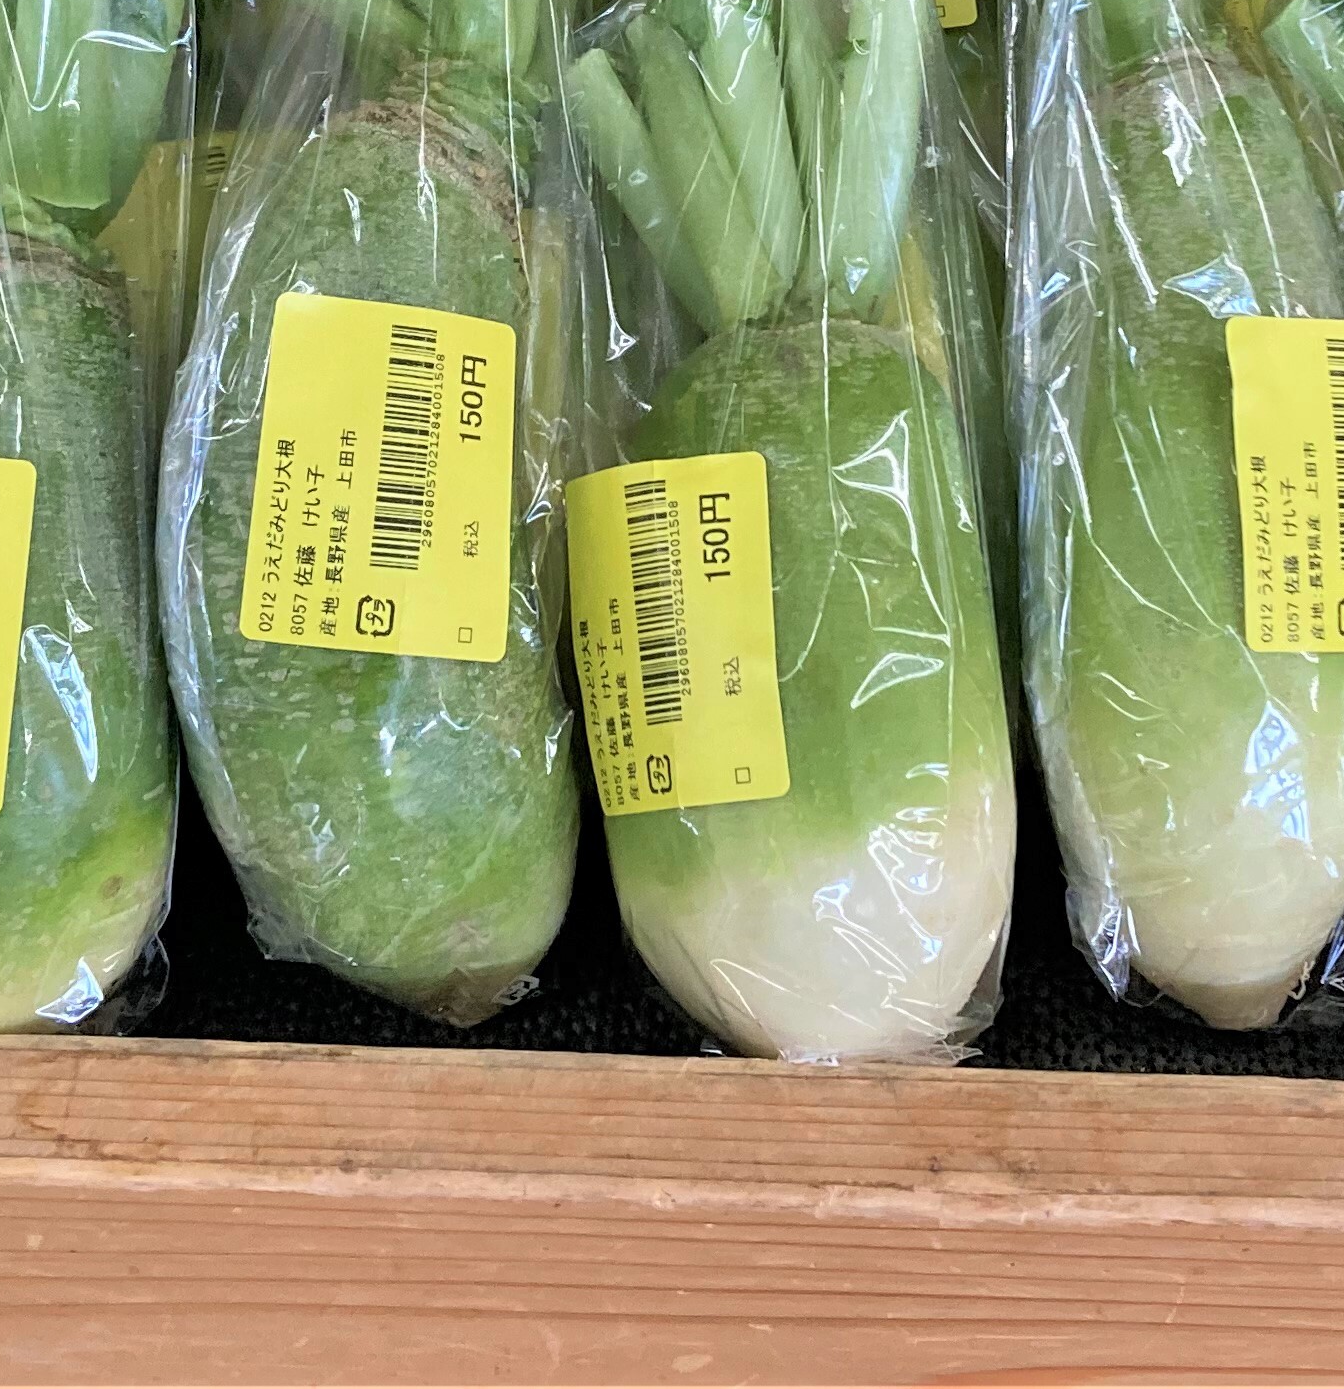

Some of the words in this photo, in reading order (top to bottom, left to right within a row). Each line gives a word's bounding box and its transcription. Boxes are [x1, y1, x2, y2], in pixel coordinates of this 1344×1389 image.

[458, 354, 487, 442] 150円
[335, 428, 357, 489] 上田市
[419, 353, 445, 548] 29608057021284001508
[1302, 441, 1318, 497] 上田市
[261, 438, 295, 583] うえだみどり大根
[301, 464, 325, 527] けい子
[1279, 477, 1298, 537] けい子
[462, 520, 479, 558] 税込
[698, 492, 731, 581] 150円
[1249, 455, 1273, 594] うえだみどり大根
[293, 544, 316, 586] 佐藤
[1282, 555, 1300, 595] 佐藤
[257, 591, 277, 632] 0212
[289, 592, 308, 636] 8057
[607, 597, 623, 655] 上田市
[667, 500, 691, 696] 29608057021284001508
[1259, 603, 1273, 643] 0212
[1285, 601, 1300, 642] 8057
[578, 619, 605, 759] うえだみどり大根
[595, 638, 611, 699] けい子
[722, 655, 742, 696] 税込
[605, 716, 619, 757] 佐藤
[599, 767, 612, 808] 0212
[611, 764, 625, 806] 8057
